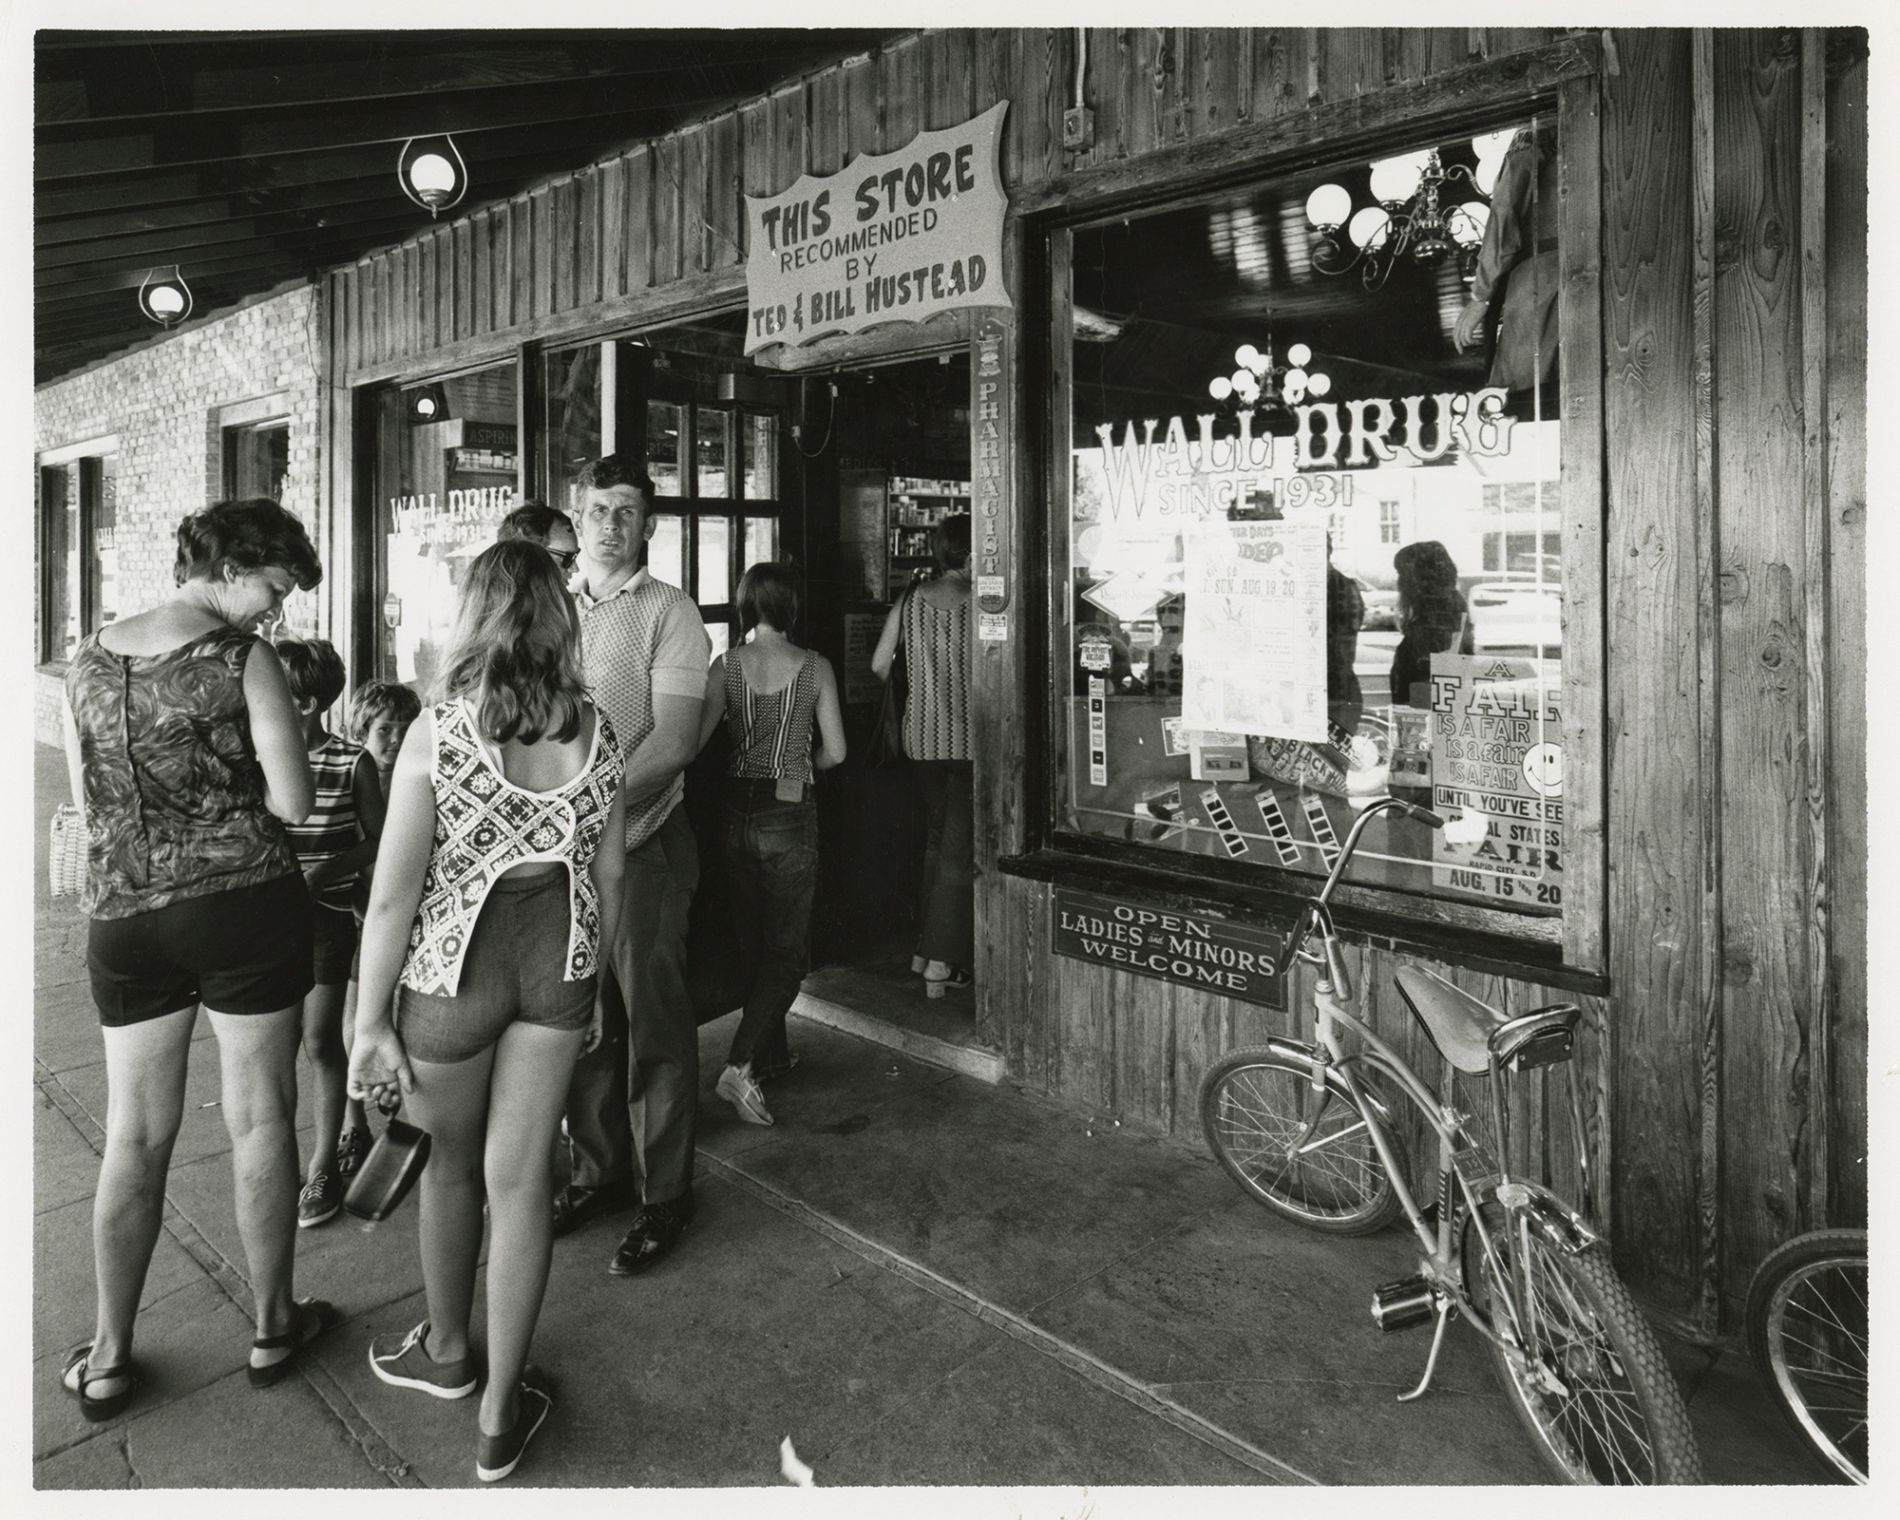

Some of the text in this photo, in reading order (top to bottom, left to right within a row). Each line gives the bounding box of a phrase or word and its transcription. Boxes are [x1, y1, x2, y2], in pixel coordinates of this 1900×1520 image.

[761, 143, 975, 252] THIS STORE
[780, 208, 938, 274] RECOMMENDED
[845, 253, 877, 281] BY
[753, 254, 986, 337] TED & BILL HUSTEAD
[1095, 387, 1517, 522] WALL DRUG
[978, 381, 999, 575] PHARMACIST
[1159, 474, 1353, 515] SINCE 1931
[390, 485, 513, 538] WALL DRUG
[1485, 660, 1516, 678] A
[1437, 713, 1530, 744] IS A FAIR
[1286, 739, 1329, 777] BLACK
[1446, 735, 1526, 766] is a fair
[1450, 761, 1517, 791] IS A FAIR
[1438, 788, 1474, 808] UNTIL
[1481, 795, 1530, 816] YOU'VE
[1510, 824, 1560, 847] STATES
[1450, 869, 1486, 892] AUG.
[1495, 876, 1514, 897] 15
[1537, 883, 1562, 905] 20
[1113, 906, 1211, 939] OPEN
[1060, 911, 1143, 946] LADIES
[1168, 935, 1276, 977] MINORS
[1080, 938, 1248, 991] WELCOME
